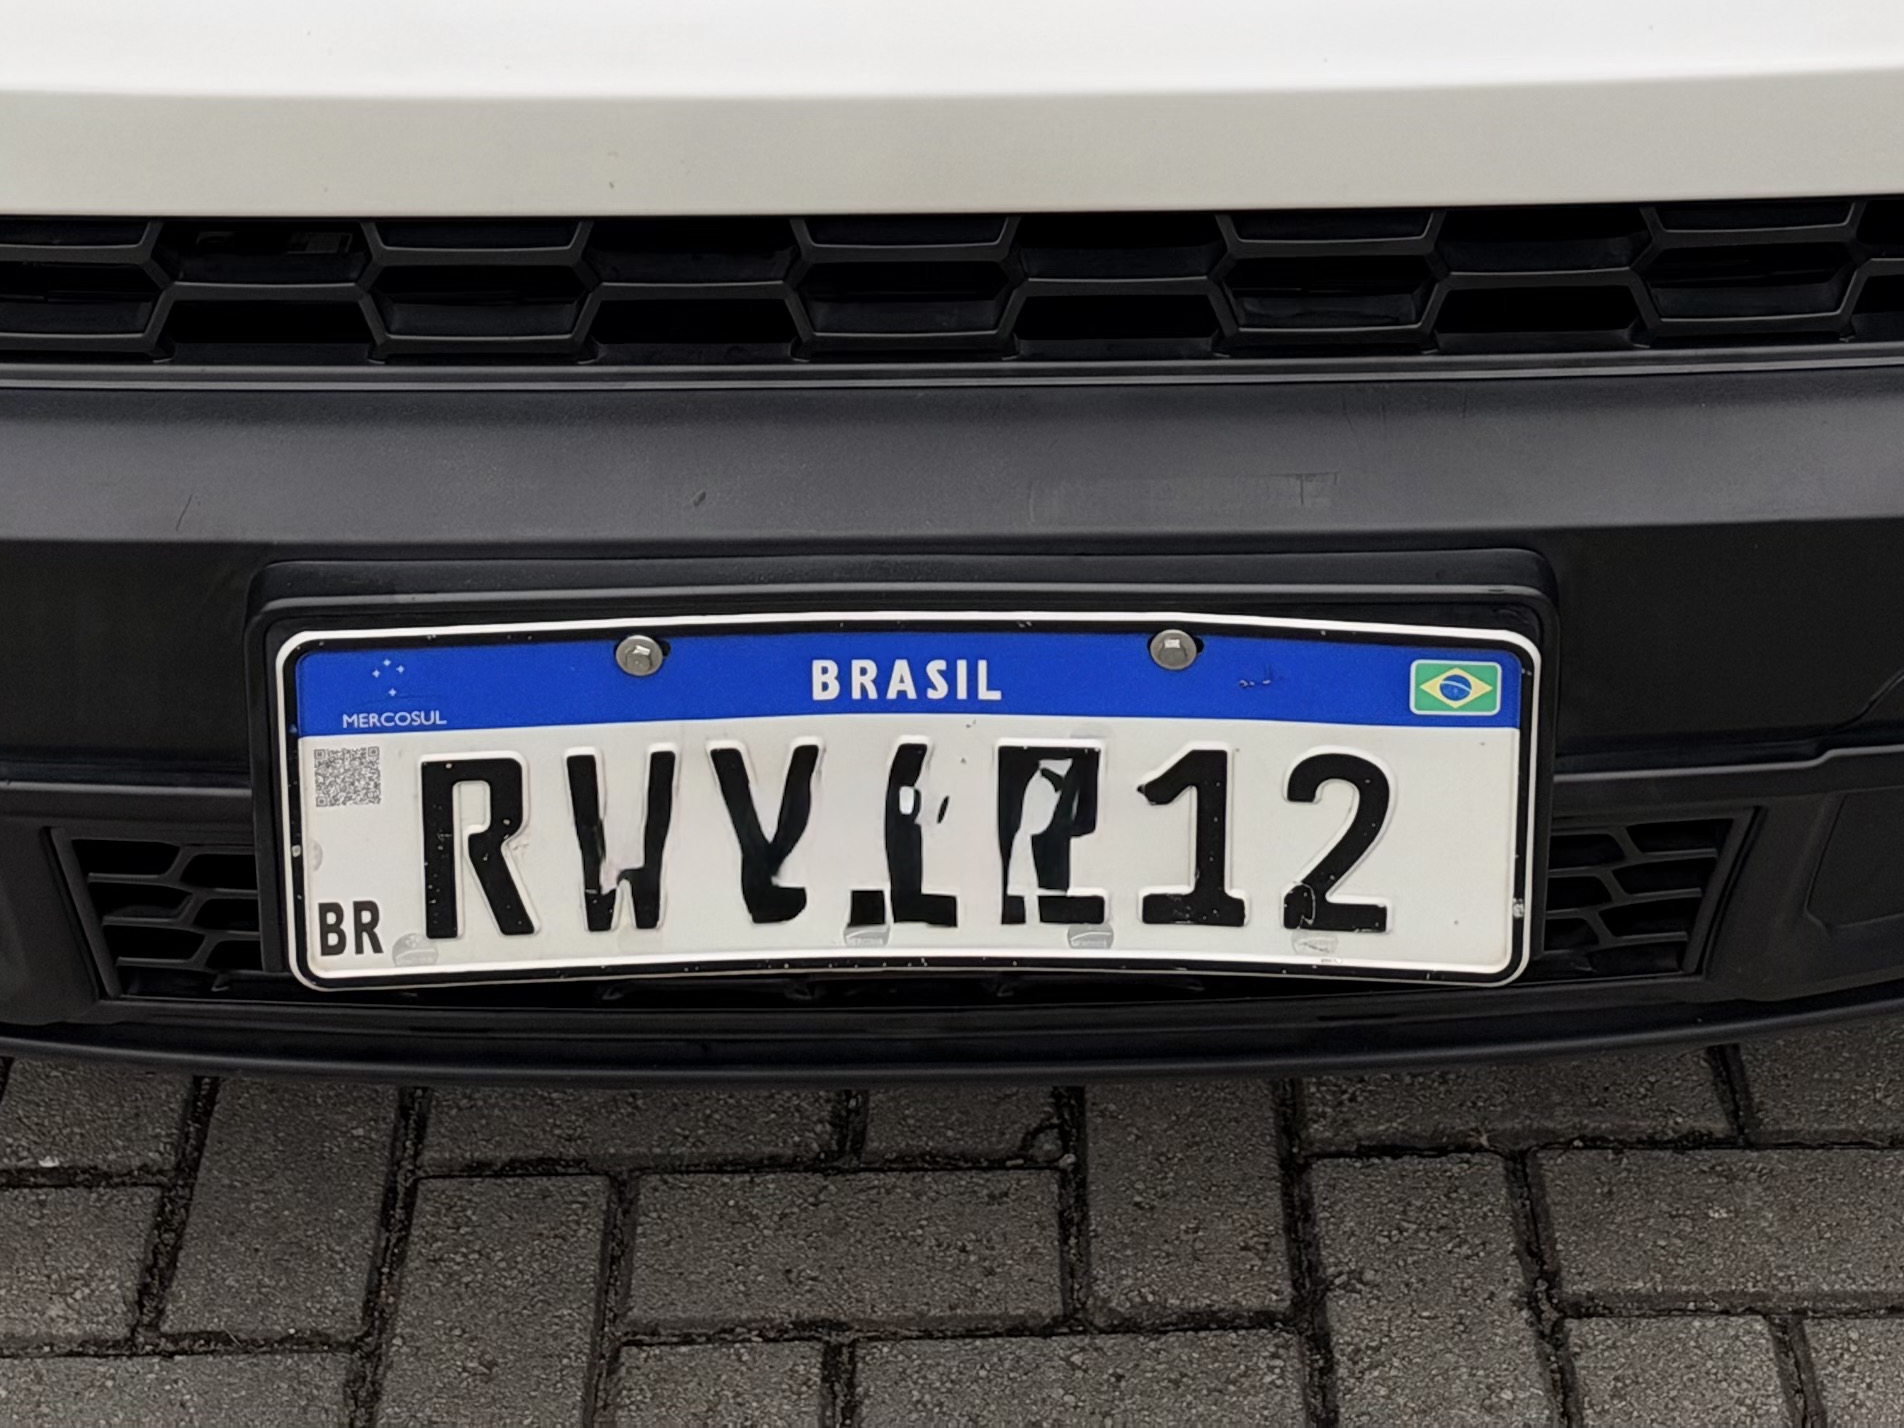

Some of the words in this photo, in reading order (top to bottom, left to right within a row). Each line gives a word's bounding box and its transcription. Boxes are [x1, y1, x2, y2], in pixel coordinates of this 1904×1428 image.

[811, 658, 1003, 701] BRASIL
[342, 710, 447, 729] MERCOSUL
[317, 900, 384, 957] BR
